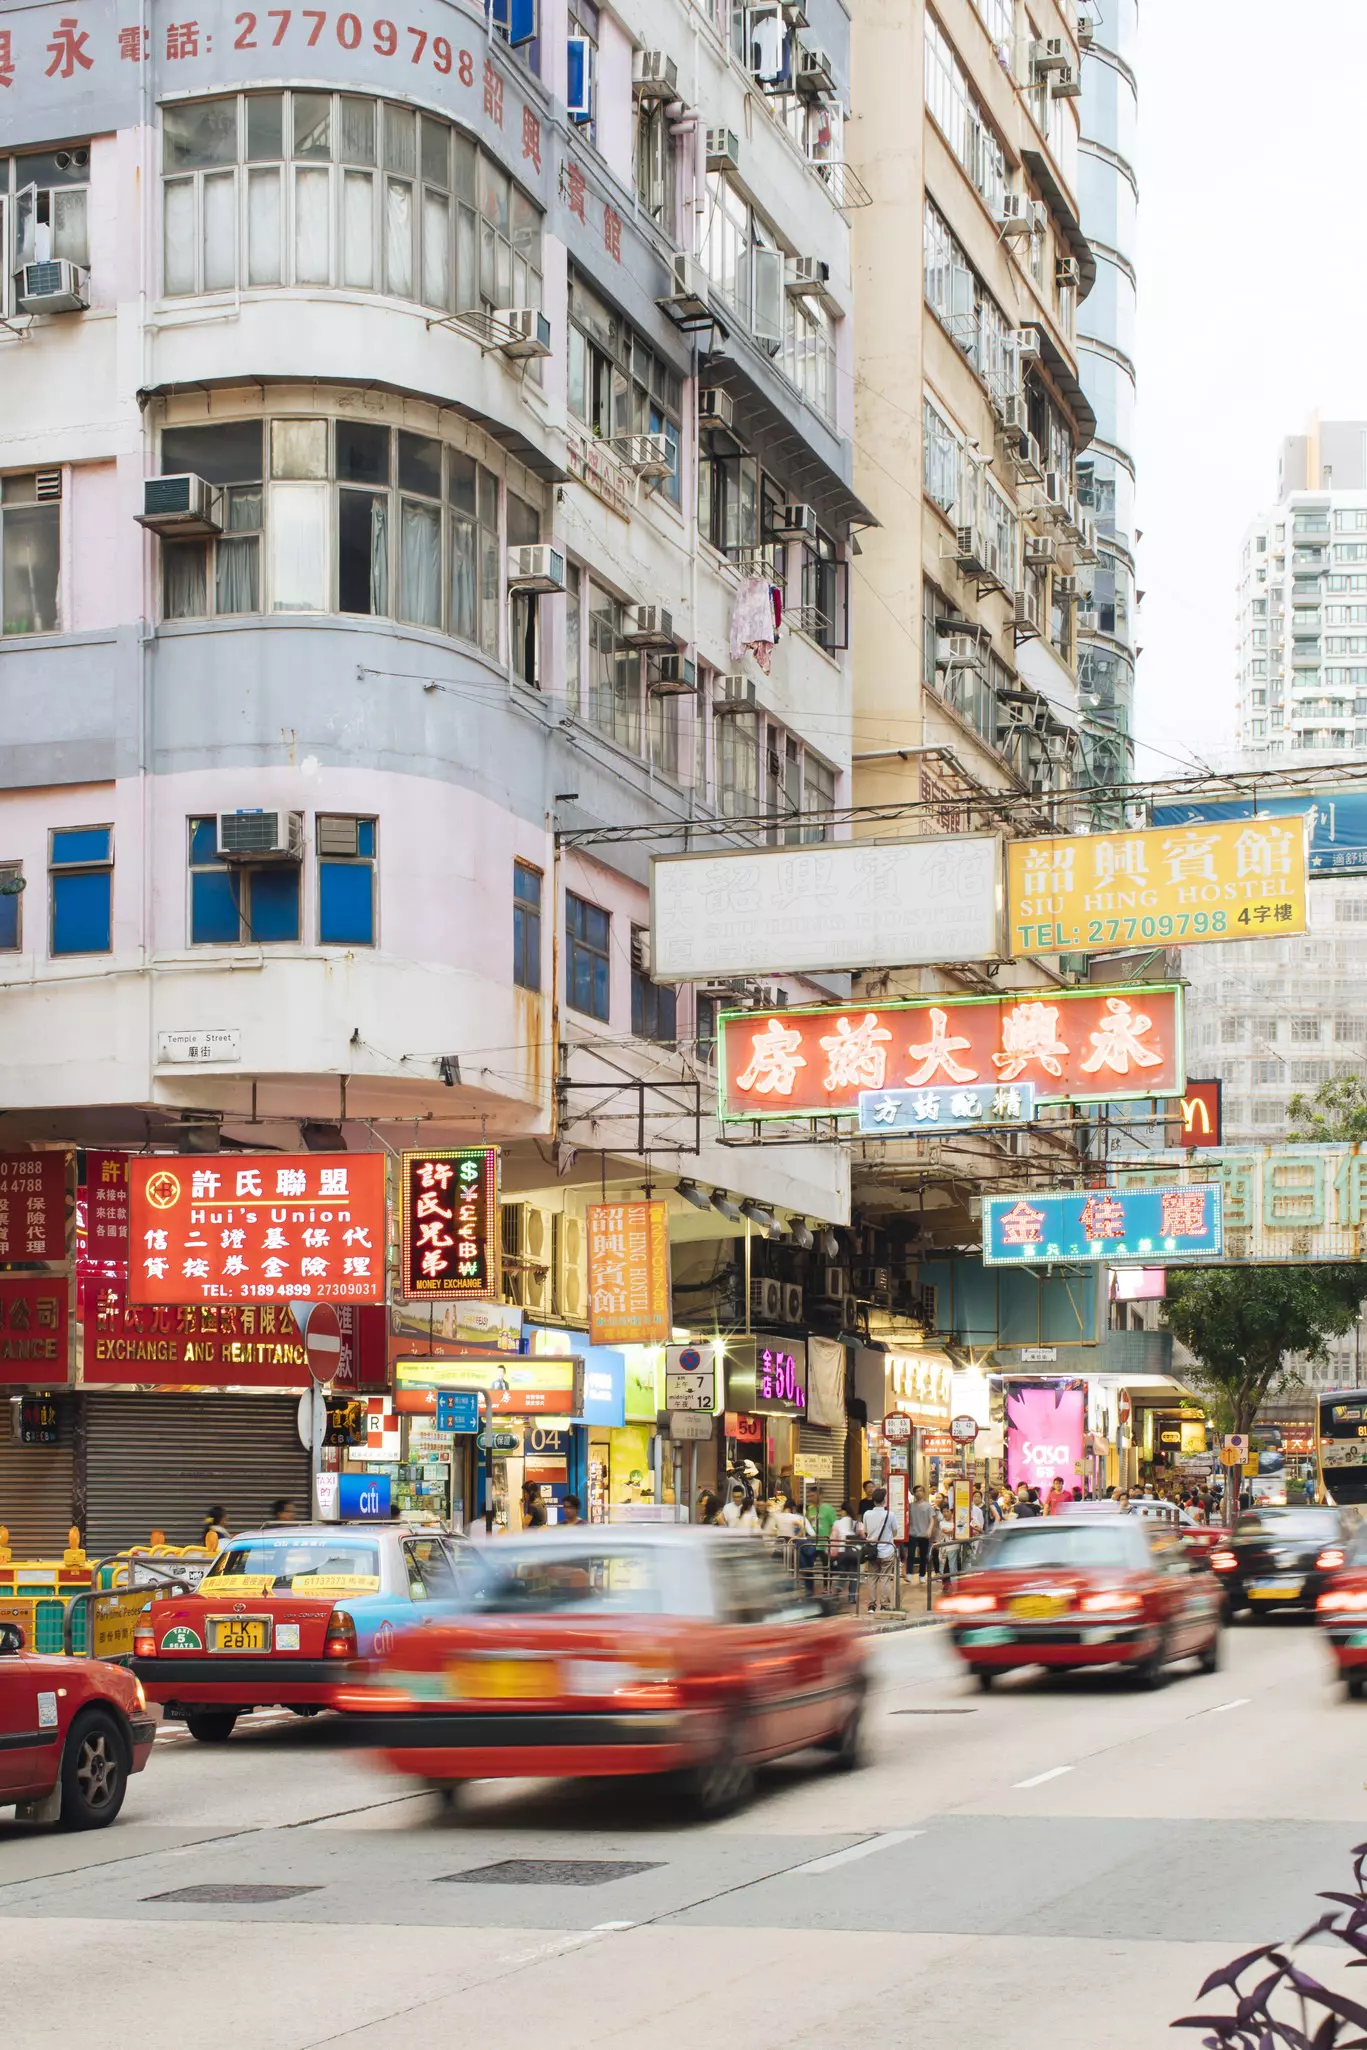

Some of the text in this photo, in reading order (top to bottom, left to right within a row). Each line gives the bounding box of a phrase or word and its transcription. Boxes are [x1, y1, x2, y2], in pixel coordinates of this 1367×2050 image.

[234, 10, 475, 87] 27709798
[483, 58, 622, 264] 韶興賓館
[1020, 826, 1294, 896] 韶興賓館
[699, 842, 990, 914] 韶興賓館
[1020, 878, 1294, 916] SIU HING HOSTEL
[1237, 903, 1293, 925] 4字樓
[1017, 910, 1228, 948] TEL: 27709798
[168, 1034, 231, 1043] Temple Street
[188, 1046, 211, 1057] 廟街
[11, 1161, 42, 1175] 7888
[11, 1179, 42, 1192] 4788
[191, 1168, 349, 1197] 許氏聯盟
[26, 1197, 46, 1253] 保險代理
[191, 1208, 351, 1224] Hui's Union
[416, 1163, 454, 1277] 許氏兄弟
[1000, 1192, 1207, 1243] 金佳麗
[592, 1207, 628, 1313] 韶興賓館
[628, 1208, 648, 1313] SIU HING HOSTEL
[202, 1284, 377, 1297] TEL: 3189 4899 27309031
[416, 1279, 482, 1289] MONEY EXCHANGE
[96, 1339, 308, 1364] EXCHANGE AND REMITTANC
[697, 1377, 705, 1388] 7
[697, 1396, 711, 1408] 12
[739, 1421, 757, 1435] 50
[317, 1477, 336, 1485] TAXI
[230, 1622, 249, 1635] LK
[178, 1634, 186, 1643] 5
[224, 1635, 257, 1648] 2811
